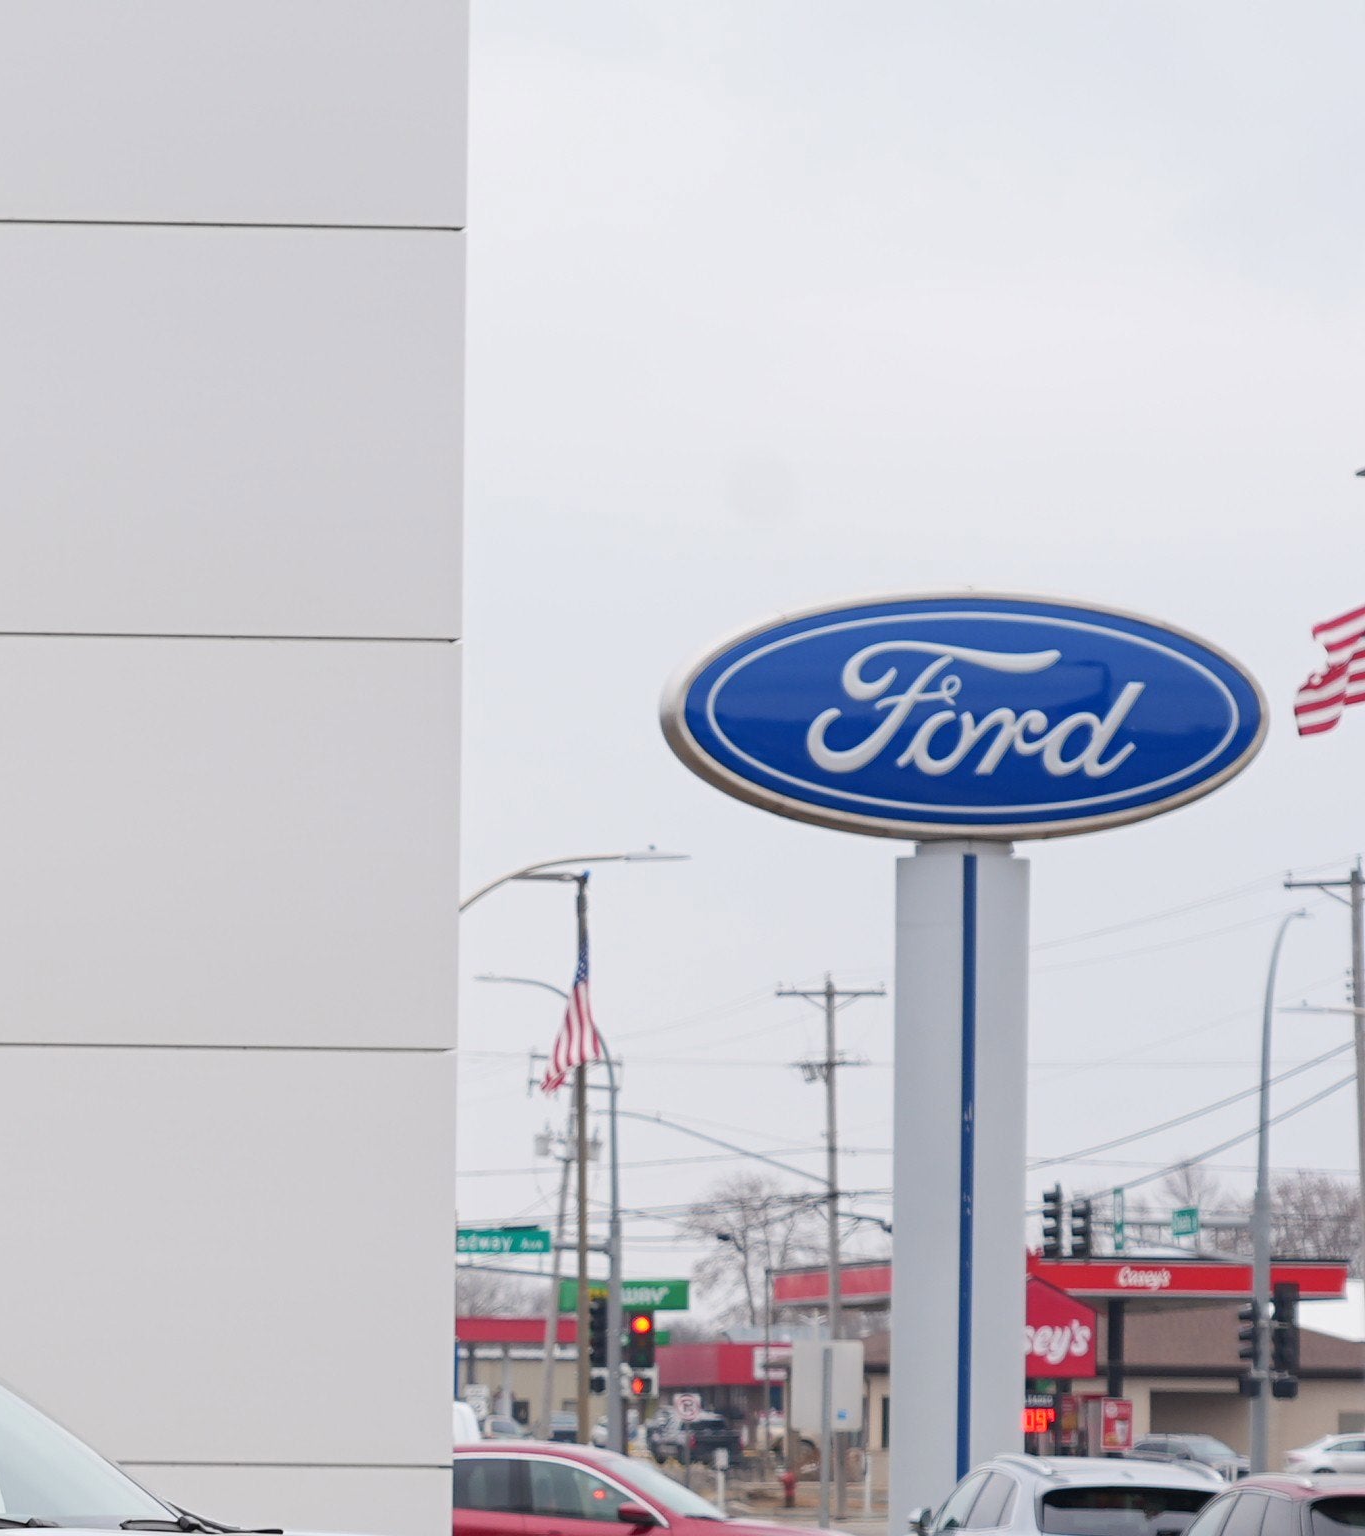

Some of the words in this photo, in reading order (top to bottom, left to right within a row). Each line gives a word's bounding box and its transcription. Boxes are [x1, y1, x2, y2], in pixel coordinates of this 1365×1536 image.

[807, 640, 1145, 778] Ford
[457, 1234, 513, 1252] adway
[1119, 1267, 1171, 1289] Casey's
[1024, 1319, 1091, 1364] sey's
